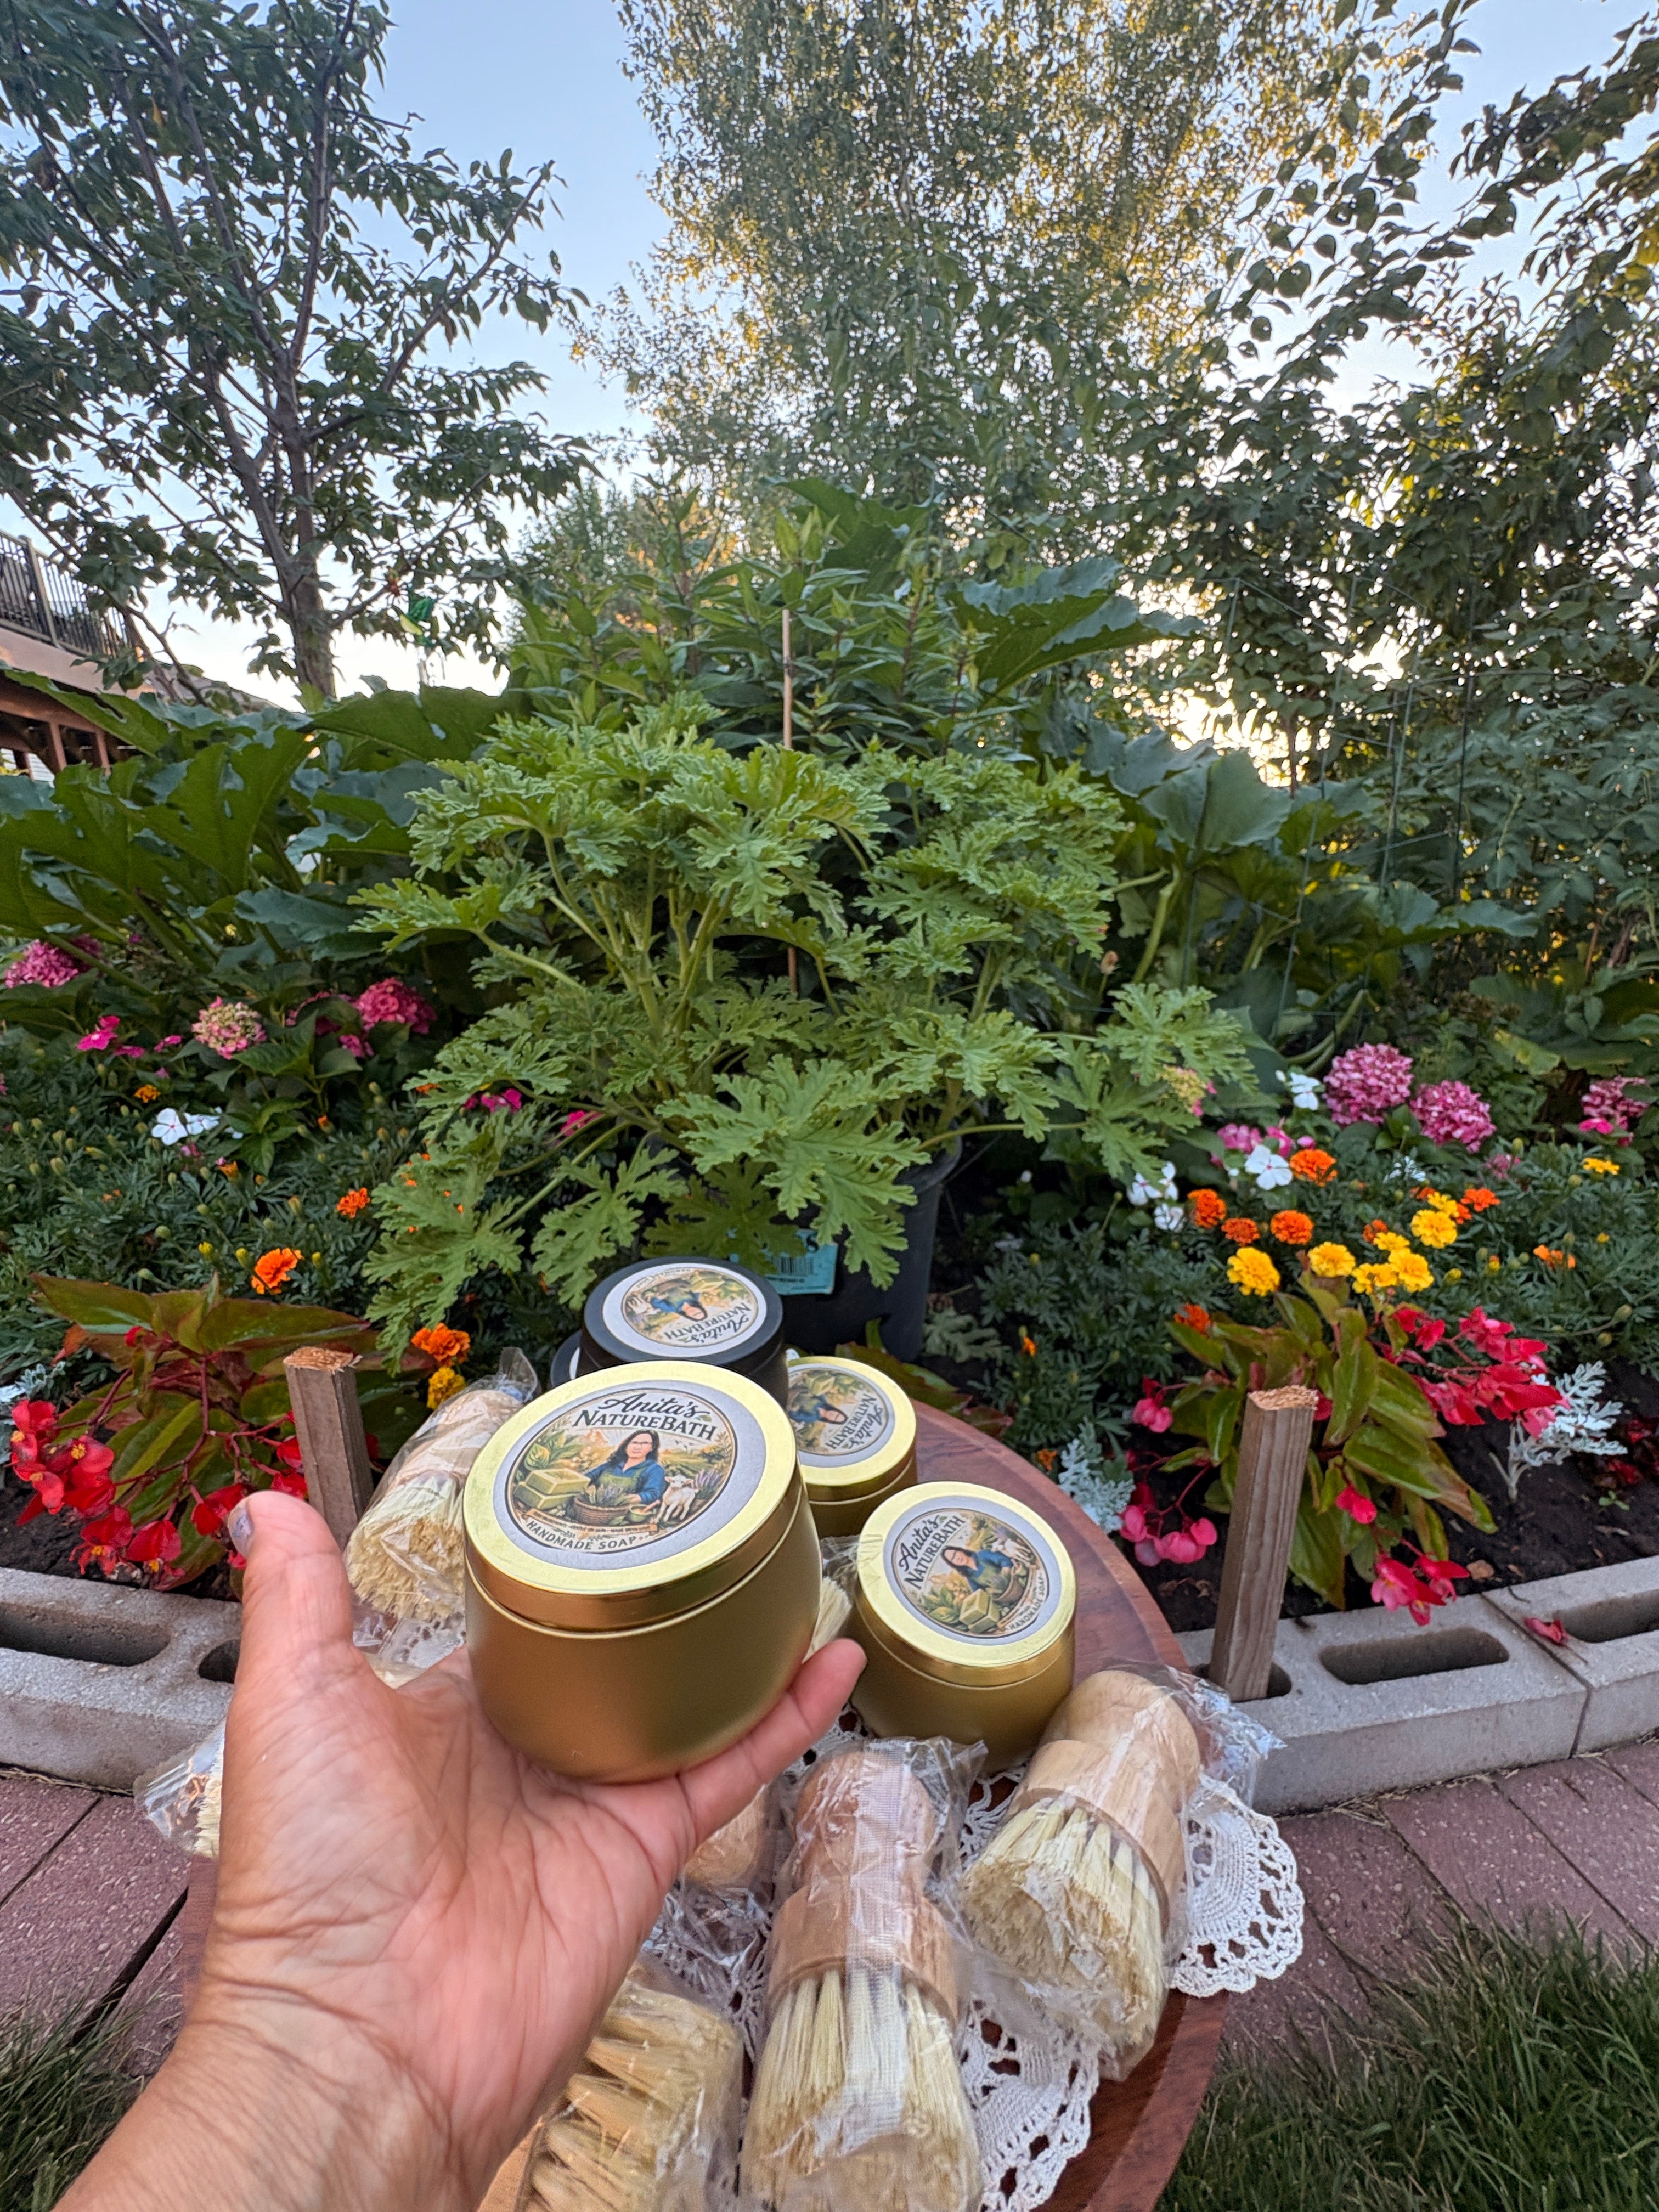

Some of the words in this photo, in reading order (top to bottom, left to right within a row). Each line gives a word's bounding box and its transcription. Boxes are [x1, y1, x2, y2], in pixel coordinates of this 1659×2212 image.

[663, 1302, 752, 1339] NATUREBATH
[682, 1317, 749, 1343] Anita's
[598, 1393, 711, 1417] Anita's
[825, 1393, 877, 1449] NATUREBATH
[573, 1410, 718, 1440] NATUREBATH
[848, 1405, 883, 1449] Anita's
[527, 1520, 591, 1550] HANDMADE
[598, 1536, 636, 1550] SOAP
[899, 1515, 940, 1572] Anita's
[904, 1515, 966, 1590] NATUREBATH
[1009, 1598, 1043, 1630] HANDMADE
